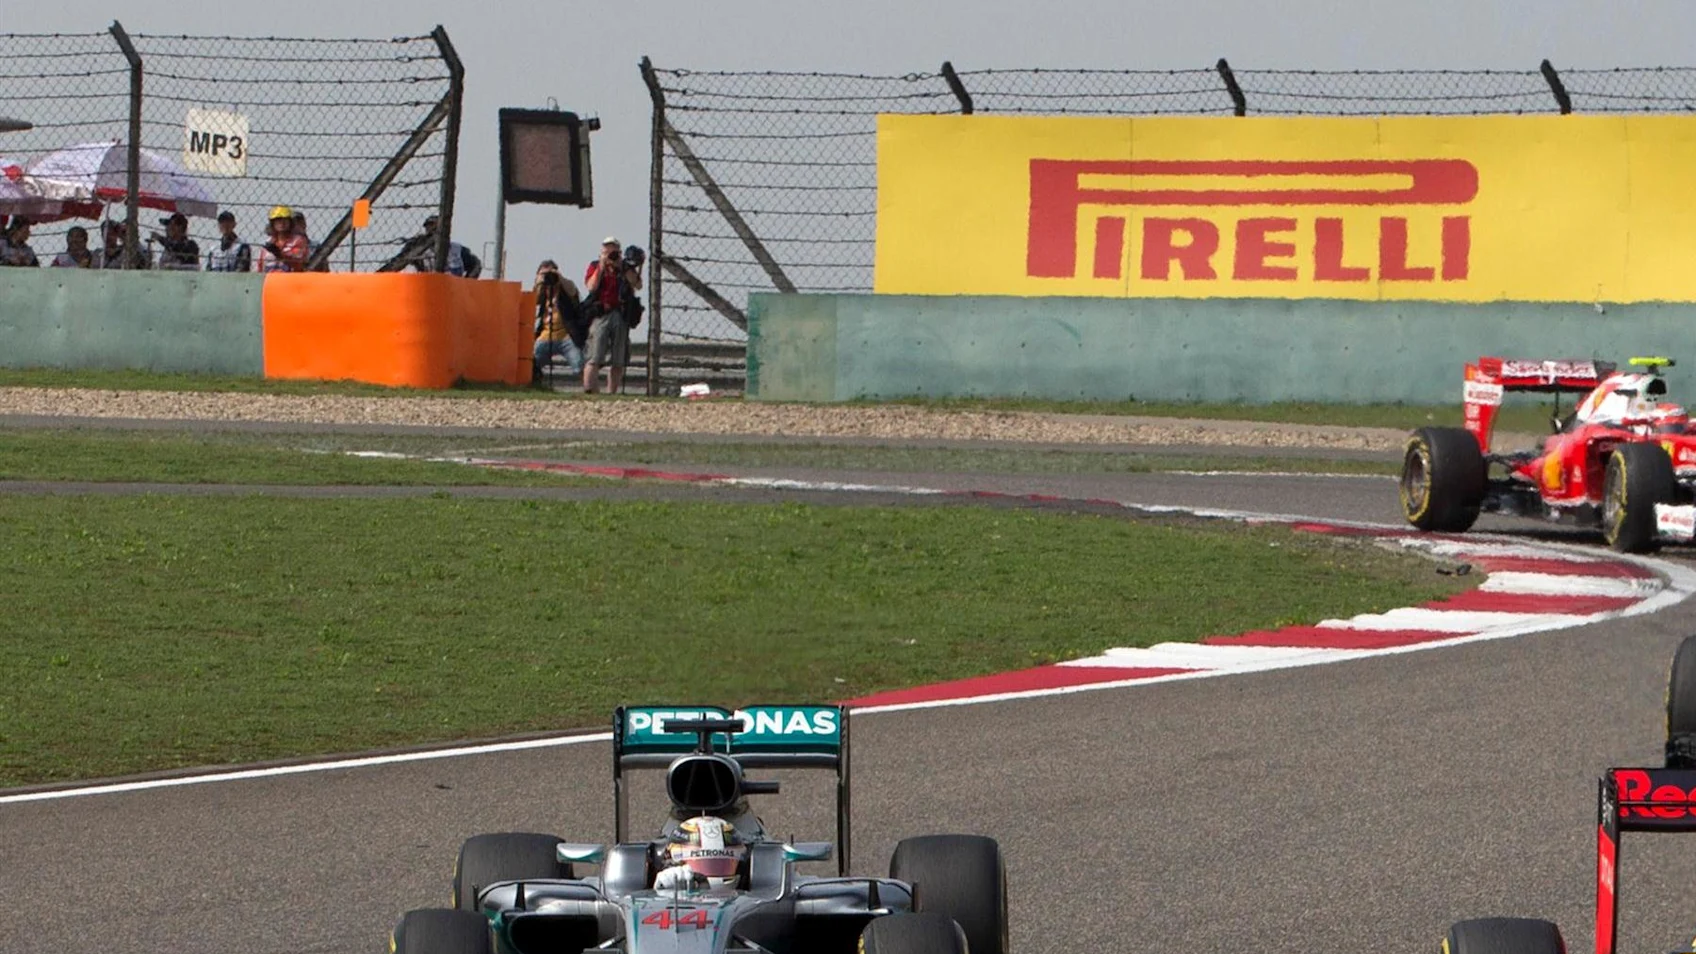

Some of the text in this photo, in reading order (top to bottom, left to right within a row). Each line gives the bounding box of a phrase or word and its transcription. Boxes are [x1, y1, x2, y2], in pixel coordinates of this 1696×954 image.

[190, 131, 242, 159] MP3
[1026, 158, 1479, 282] PIRELLI
[690, 849, 734, 857] PETRONAS
